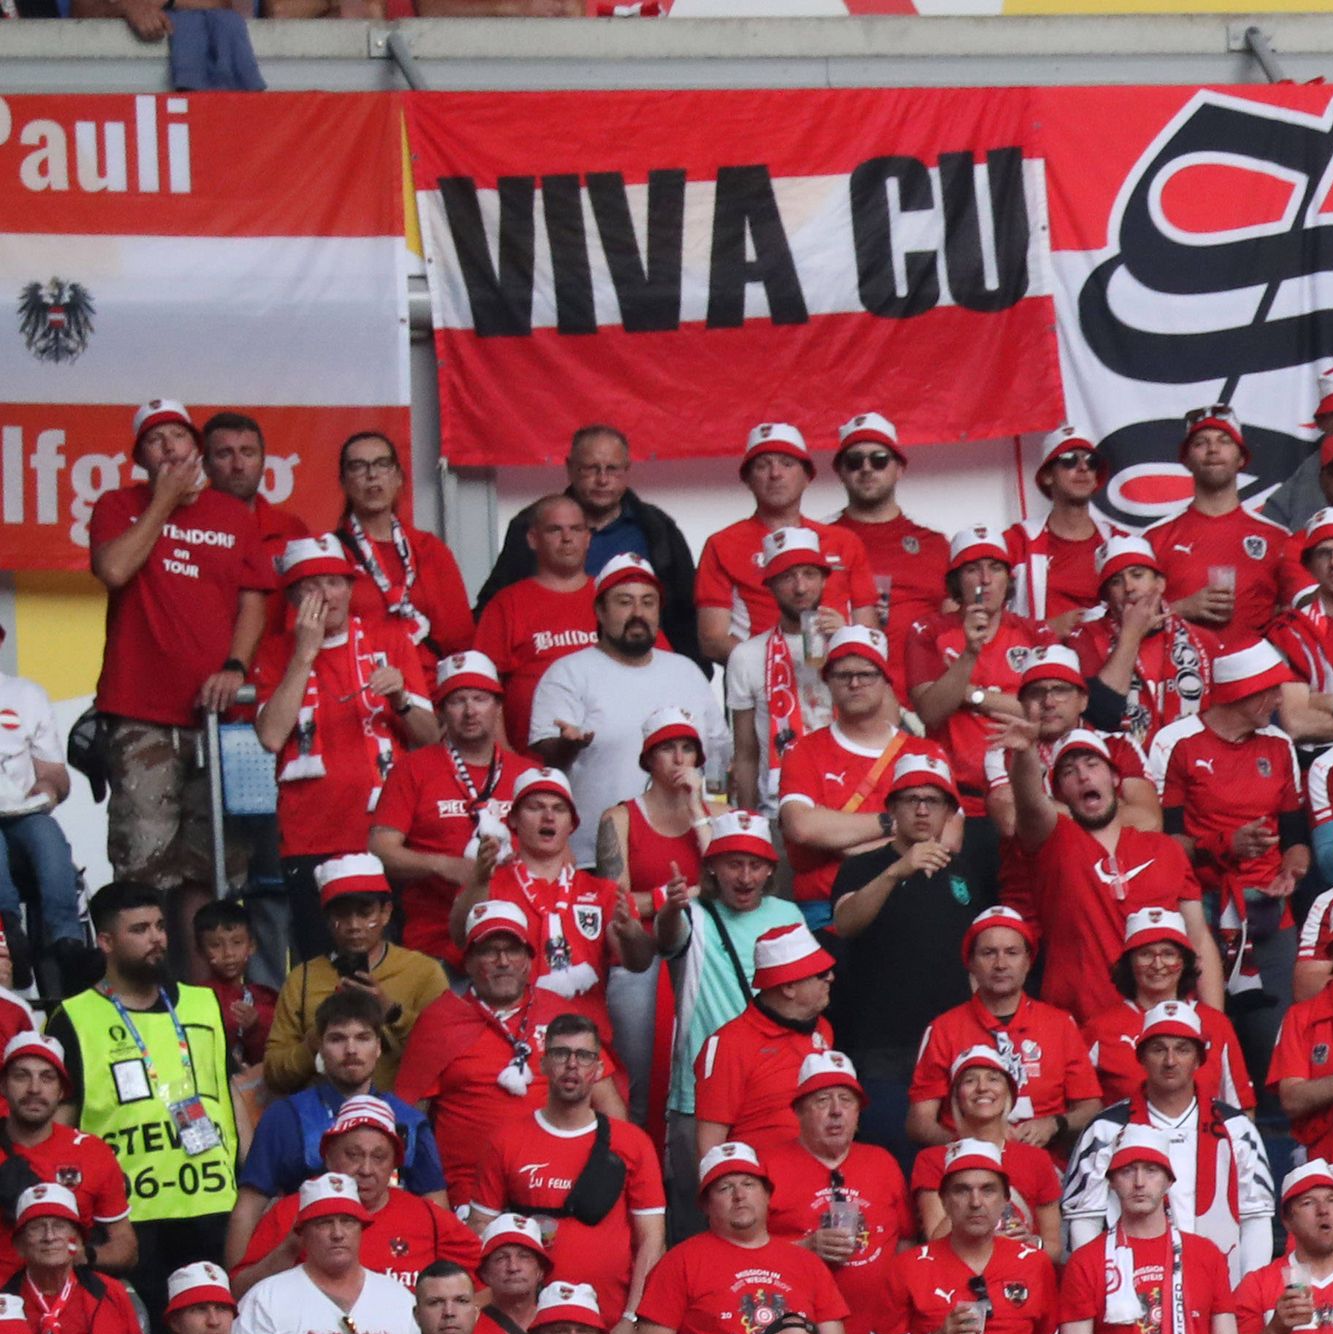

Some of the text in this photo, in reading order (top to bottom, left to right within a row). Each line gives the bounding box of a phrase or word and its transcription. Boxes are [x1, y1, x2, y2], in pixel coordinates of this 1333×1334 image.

[0, 94, 191, 194] auli
[438, 146, 1028, 337] VIVA CU
[2, 425, 298, 547] lfgg
[162, 559, 200, 579] TOUR
[174, 549, 191, 560] on
